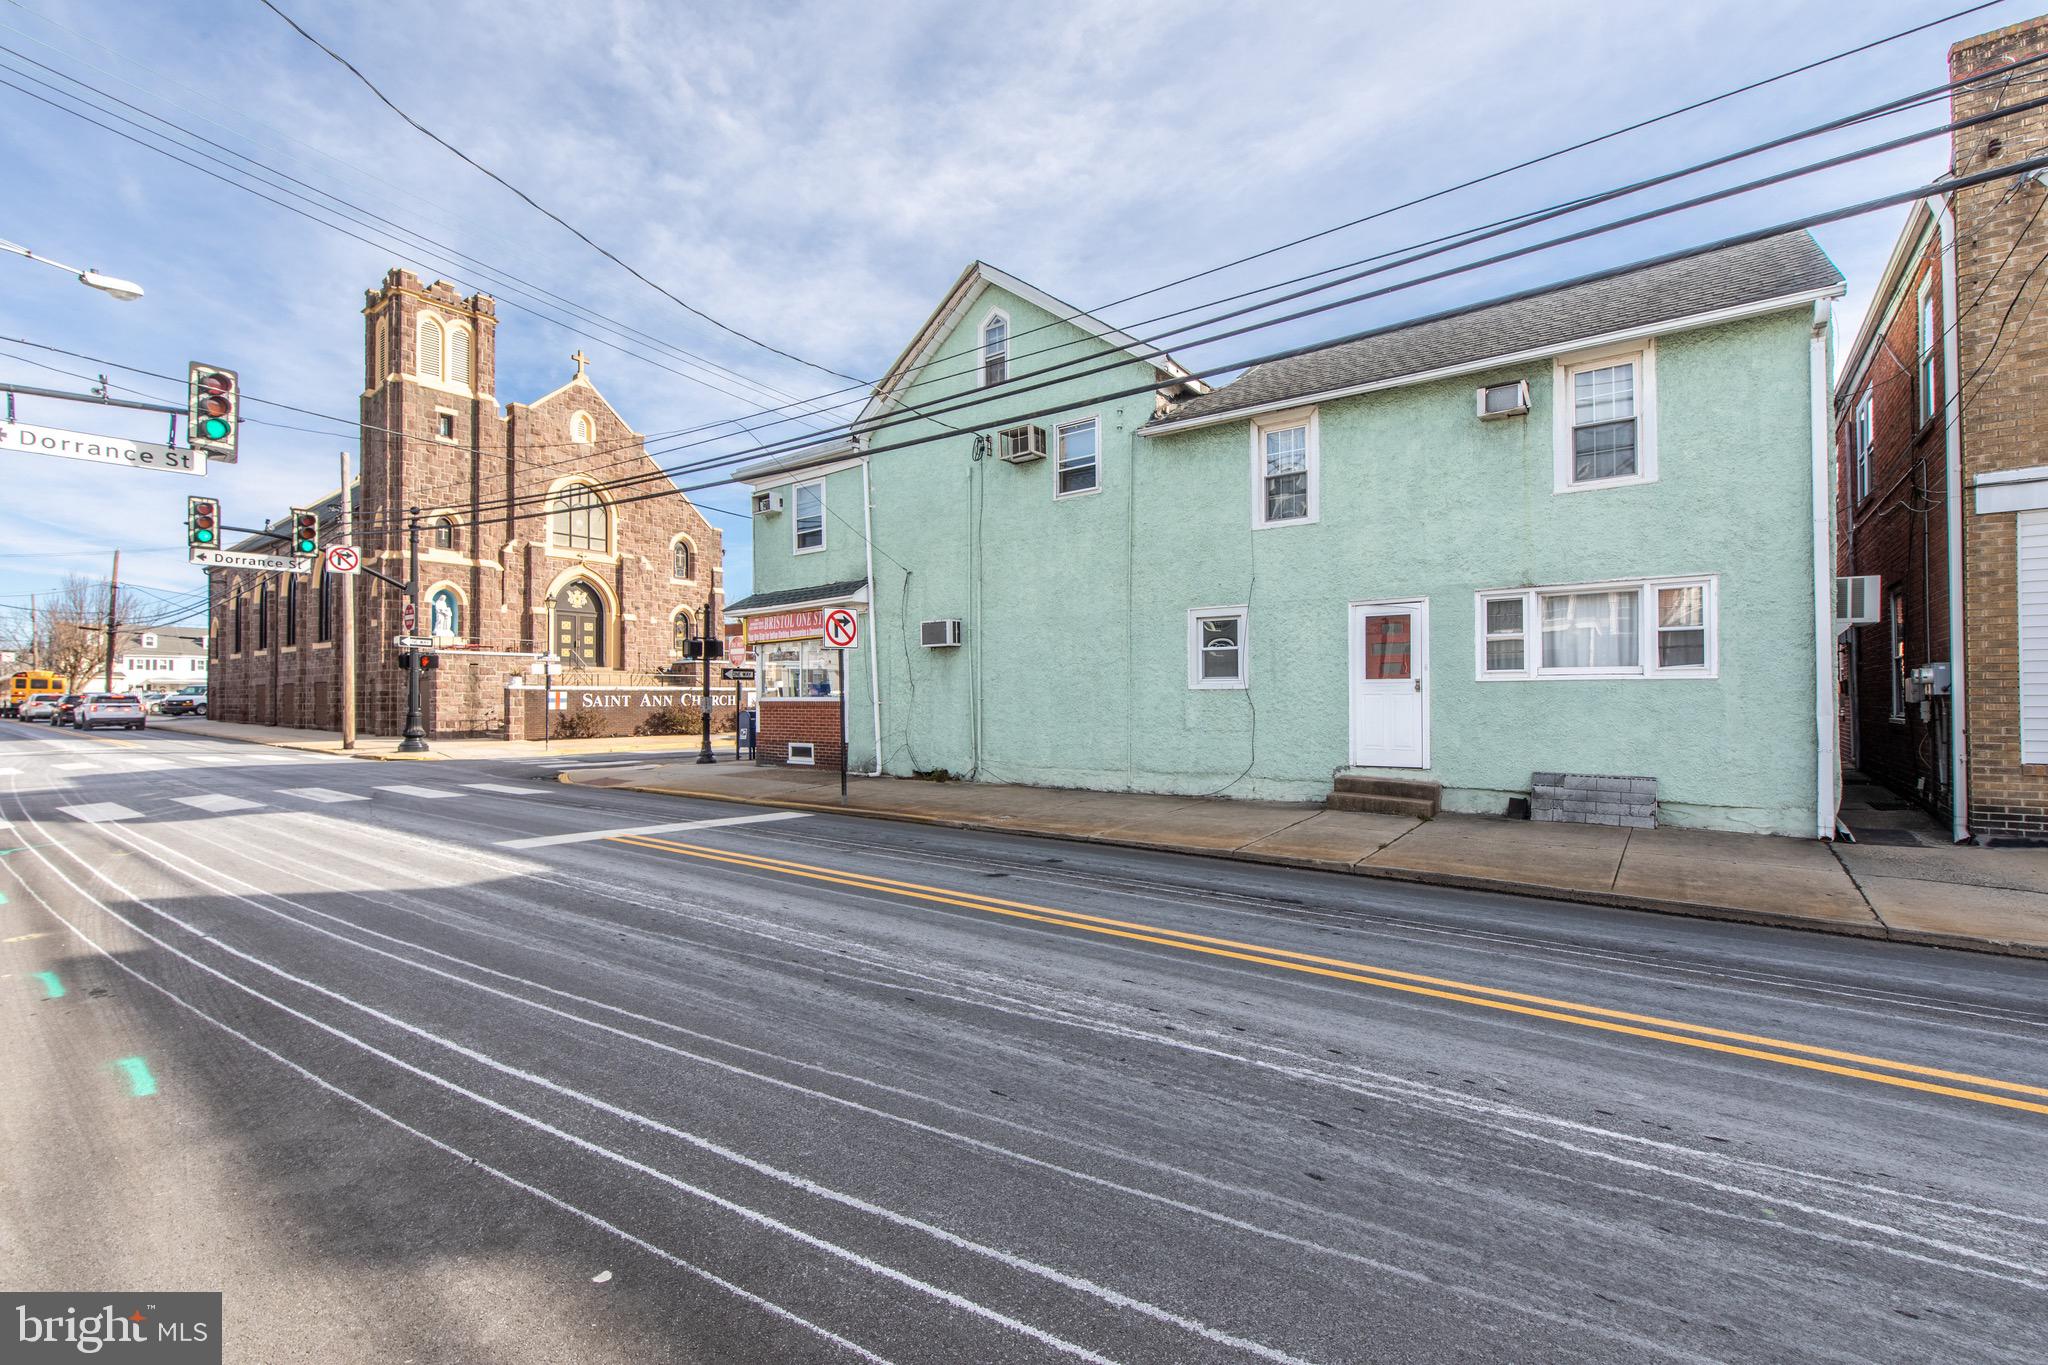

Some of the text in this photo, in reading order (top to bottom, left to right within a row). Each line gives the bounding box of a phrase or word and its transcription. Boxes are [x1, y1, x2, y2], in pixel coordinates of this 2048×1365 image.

[20, 430, 190, 469] Dorrance St
[214, 553, 302, 570] Dorrance St
[764, 615, 795, 630] BRISTOL
[796, 612, 812, 627] ONE
[582, 693, 737, 708] SAINT ANN CHRCH
